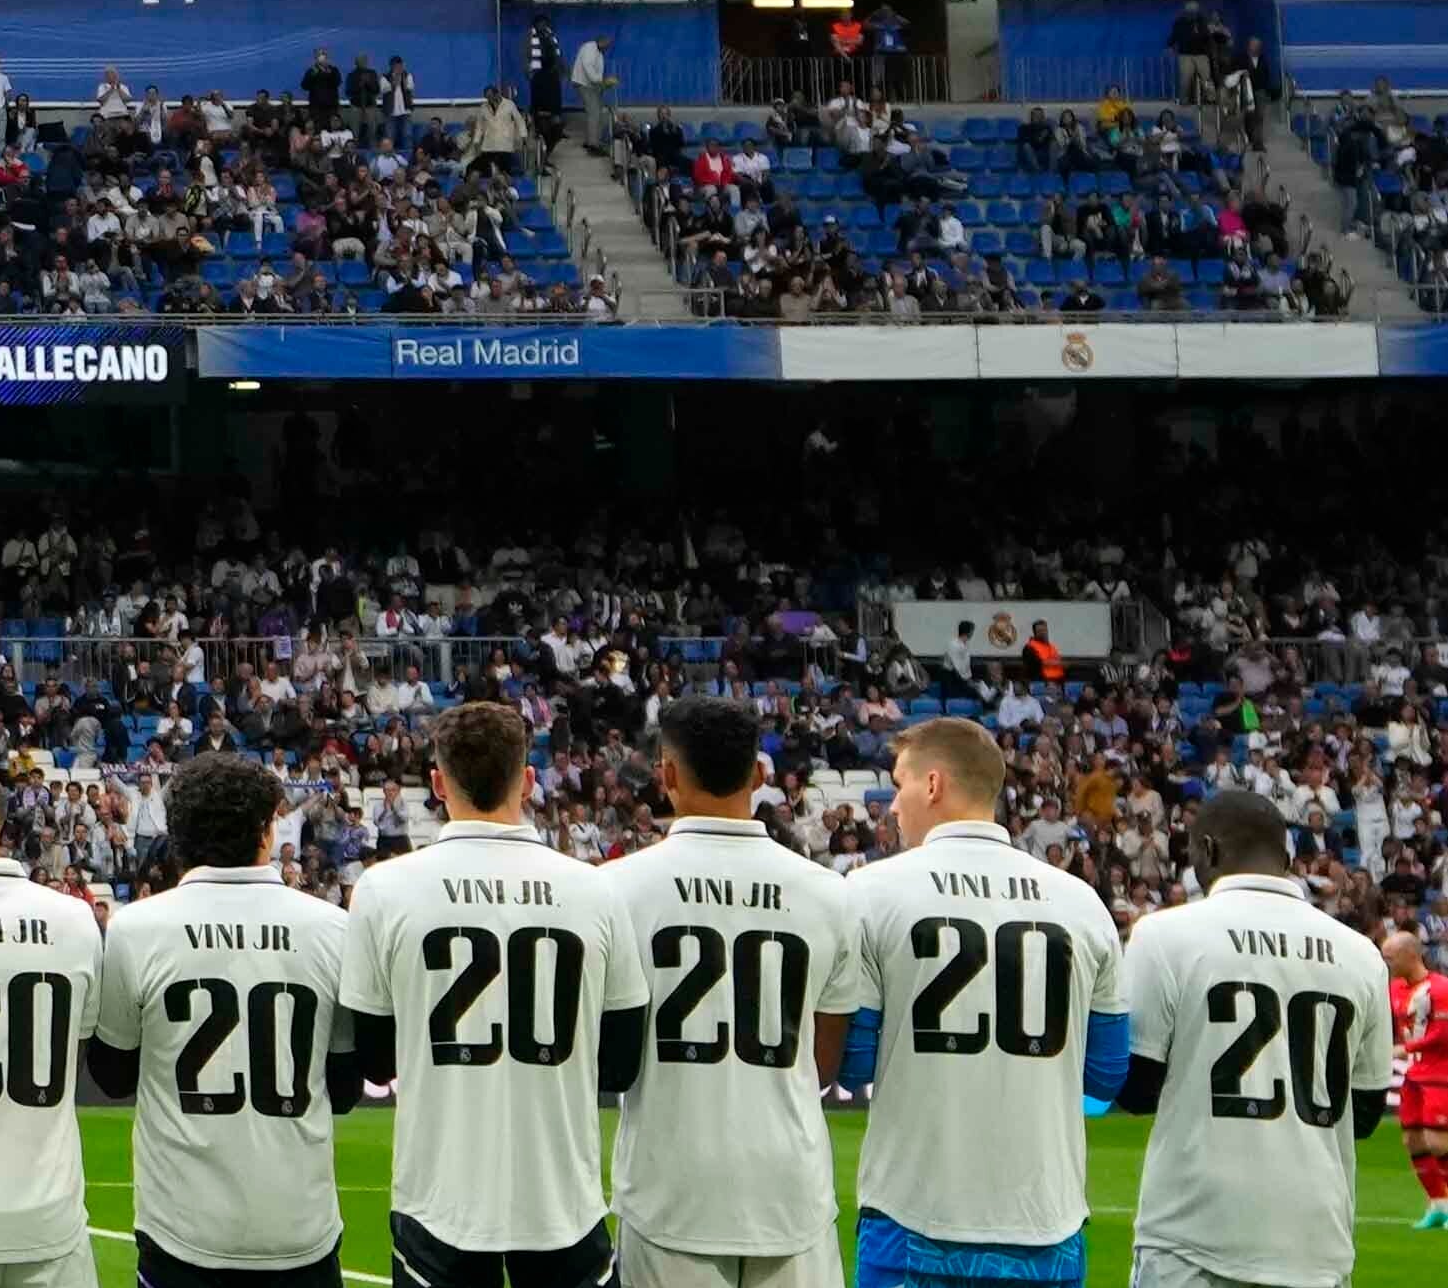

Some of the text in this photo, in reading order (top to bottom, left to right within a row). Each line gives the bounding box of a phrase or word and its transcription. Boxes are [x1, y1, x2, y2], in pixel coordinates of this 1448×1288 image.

[397, 340, 578, 364] Real Madrid
[443, 880, 560, 907] VINI JR.
[675, 878, 789, 911] VINI JR.
[931, 873, 1048, 902] VINI JR.
[13, 919, 53, 945] JR.
[185, 924, 296, 951] VINI JR.
[1228, 930, 1336, 964] VINI JR.
[422, 926, 585, 1067] 20
[651, 925, 809, 1069] 20
[910, 917, 1073, 1058] 20
[164, 978, 318, 1118] 20
[1205, 981, 1356, 1128] 20
